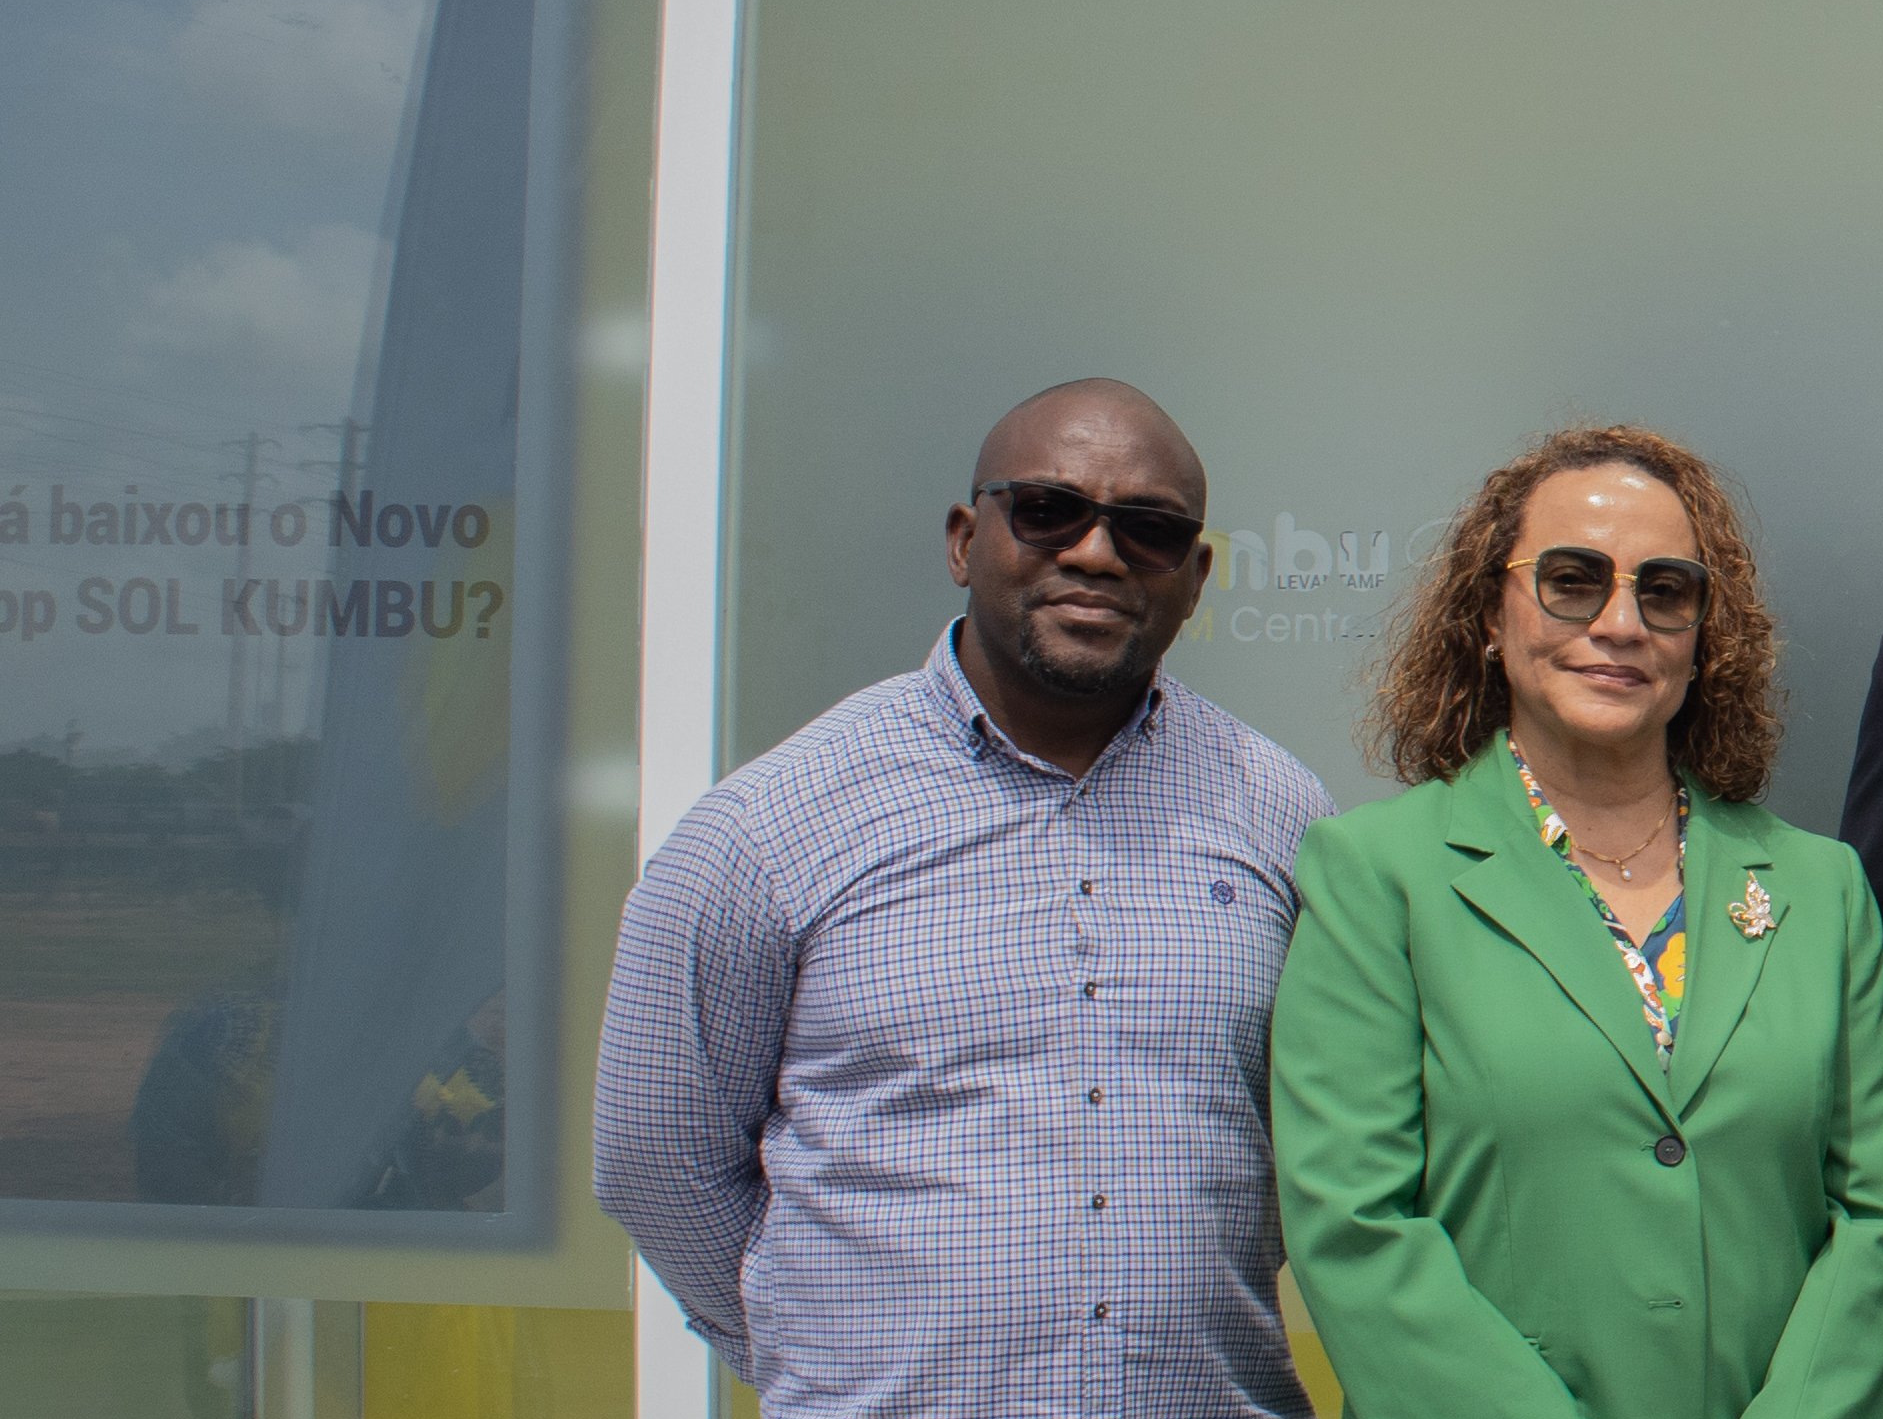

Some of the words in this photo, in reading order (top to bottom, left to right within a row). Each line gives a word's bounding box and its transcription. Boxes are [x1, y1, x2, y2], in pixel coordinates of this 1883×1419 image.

[48, 484, 252, 547] baixou
[269, 502, 309, 548] o
[331, 488, 490, 549] Novo
[74, 576, 200, 637] SOL
[220, 578, 505, 640] KUMBU?
